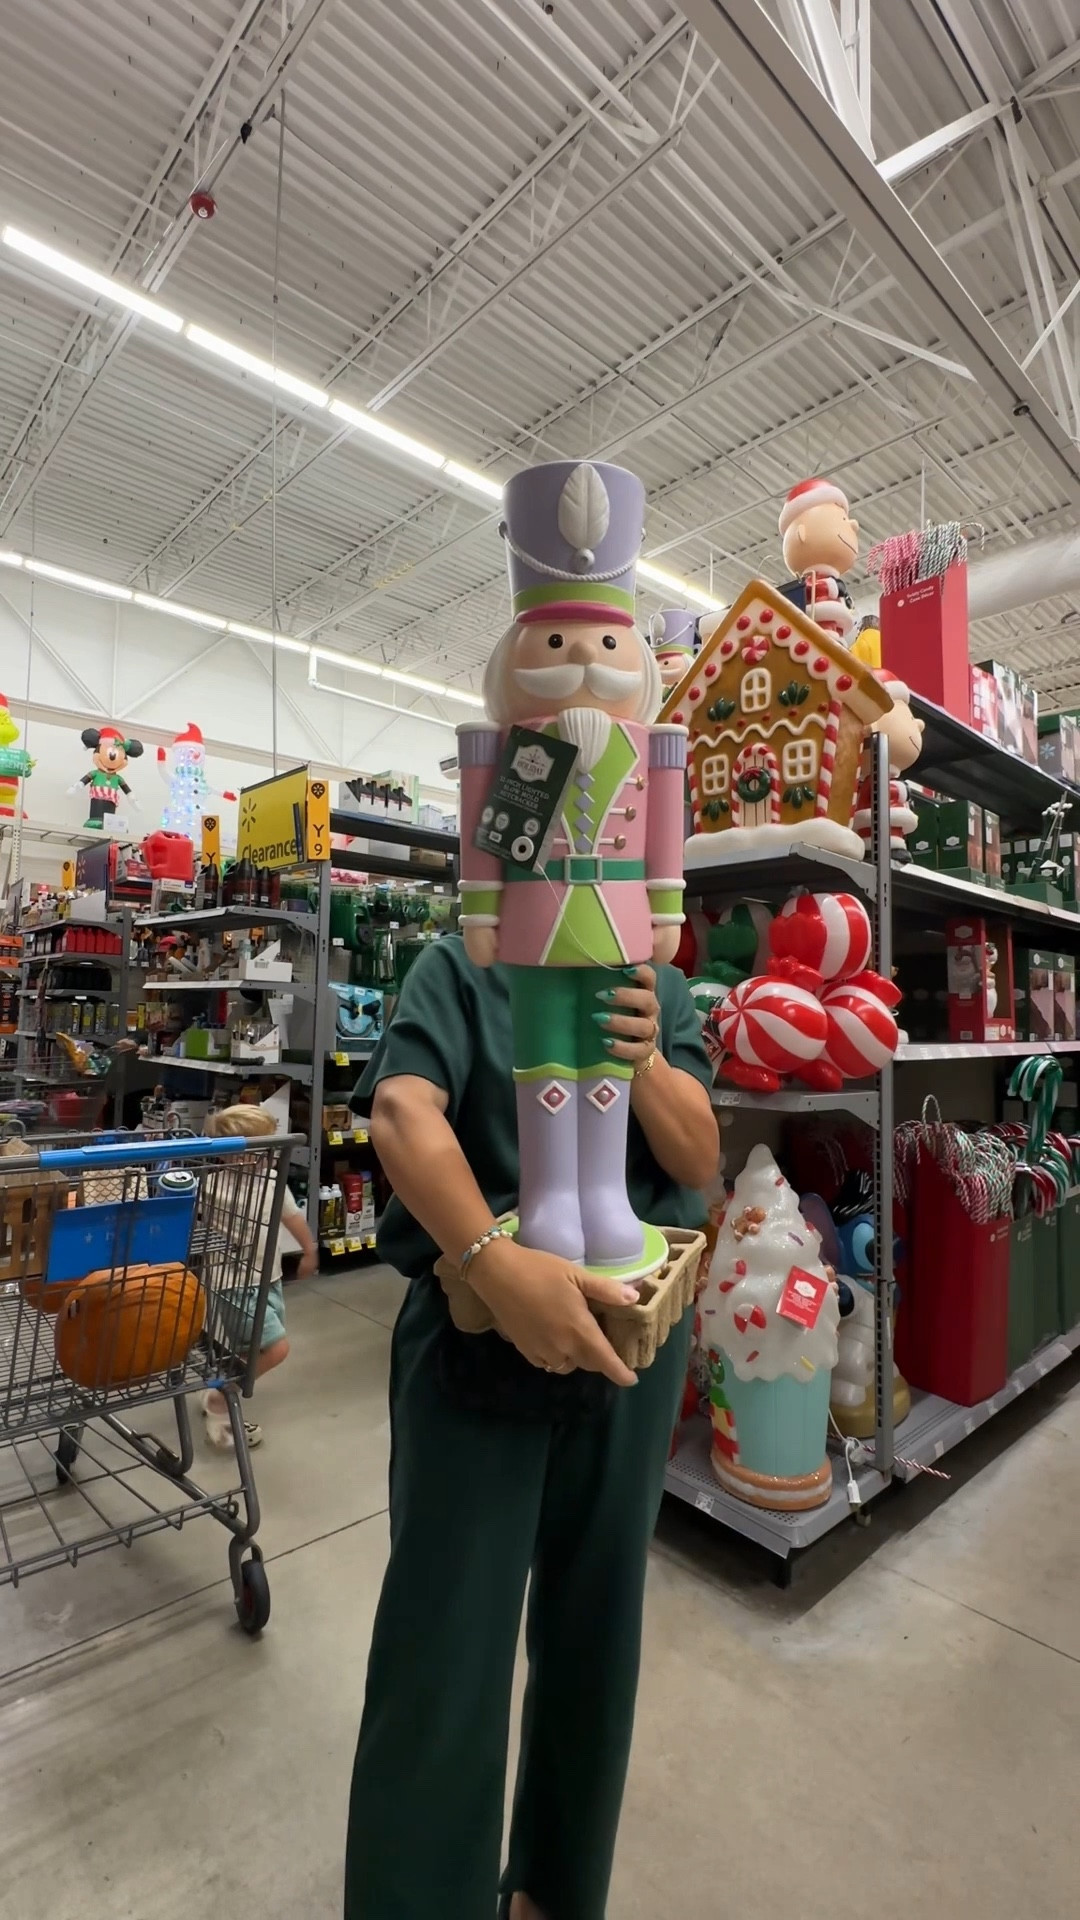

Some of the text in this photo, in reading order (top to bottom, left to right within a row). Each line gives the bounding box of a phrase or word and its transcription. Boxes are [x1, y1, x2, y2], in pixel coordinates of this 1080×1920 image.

[313, 824, 324, 838] Y
[242, 839, 297, 864] Clearance
[314, 843, 323, 856] 9
[206, 852, 216, 865] Y
